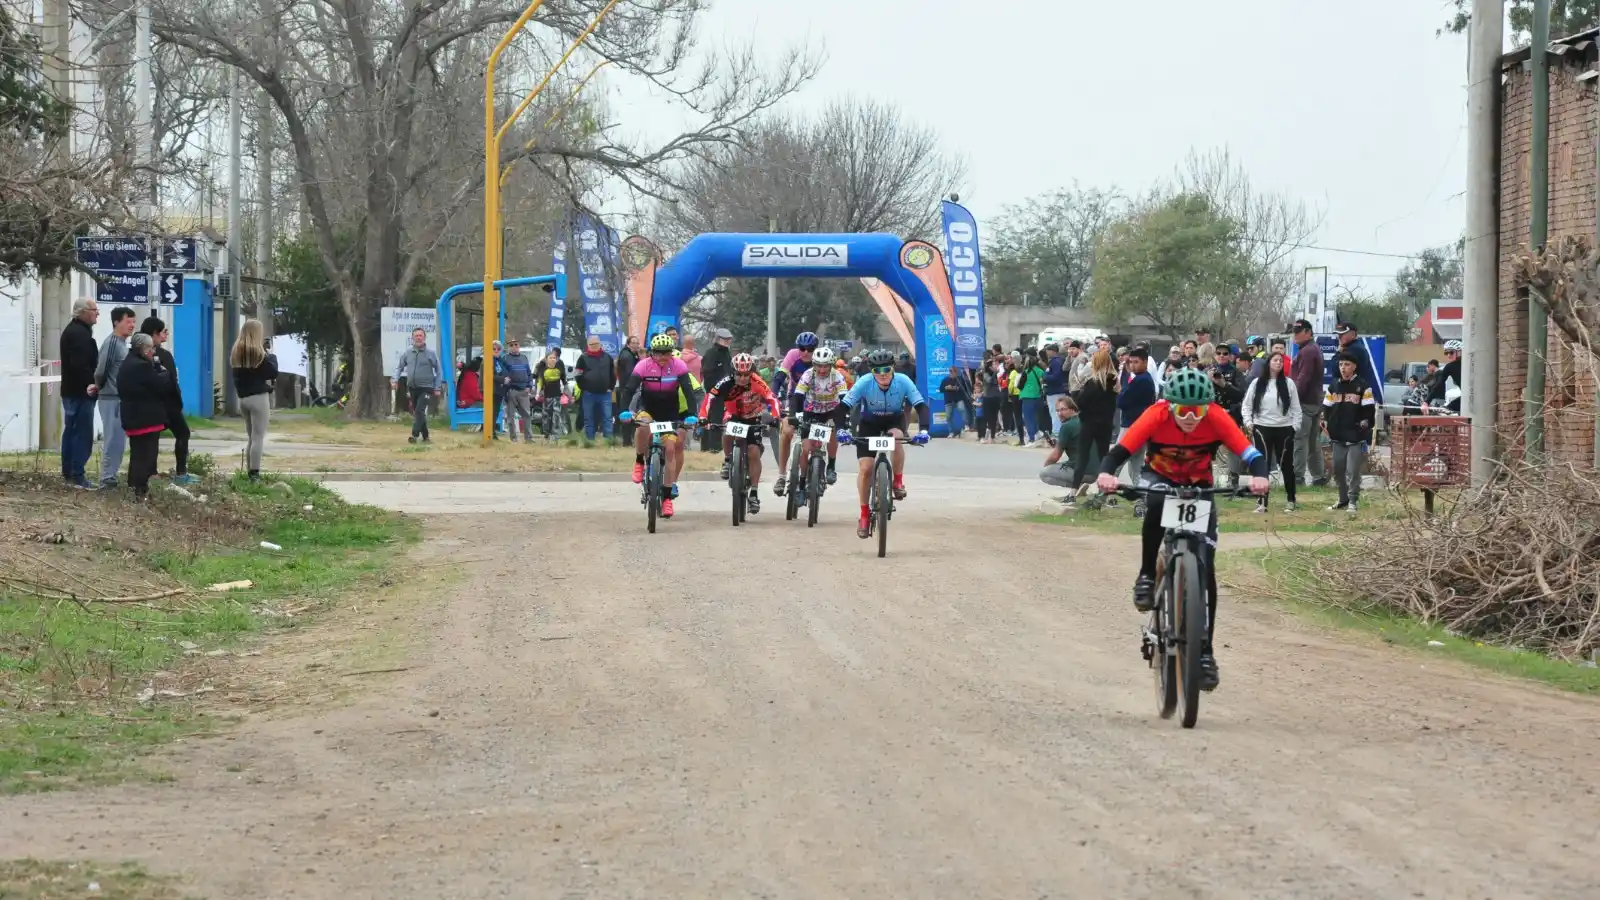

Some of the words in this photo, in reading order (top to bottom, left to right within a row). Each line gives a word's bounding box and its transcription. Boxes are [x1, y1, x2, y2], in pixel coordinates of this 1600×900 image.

[104, 242, 114, 251] de
[749, 246, 840, 258] SALIDA
[122, 275, 146, 287] Angeli
[814, 428, 826, 438] 84
[875, 439, 889, 448] 80
[1176, 503, 1197, 523] 18
